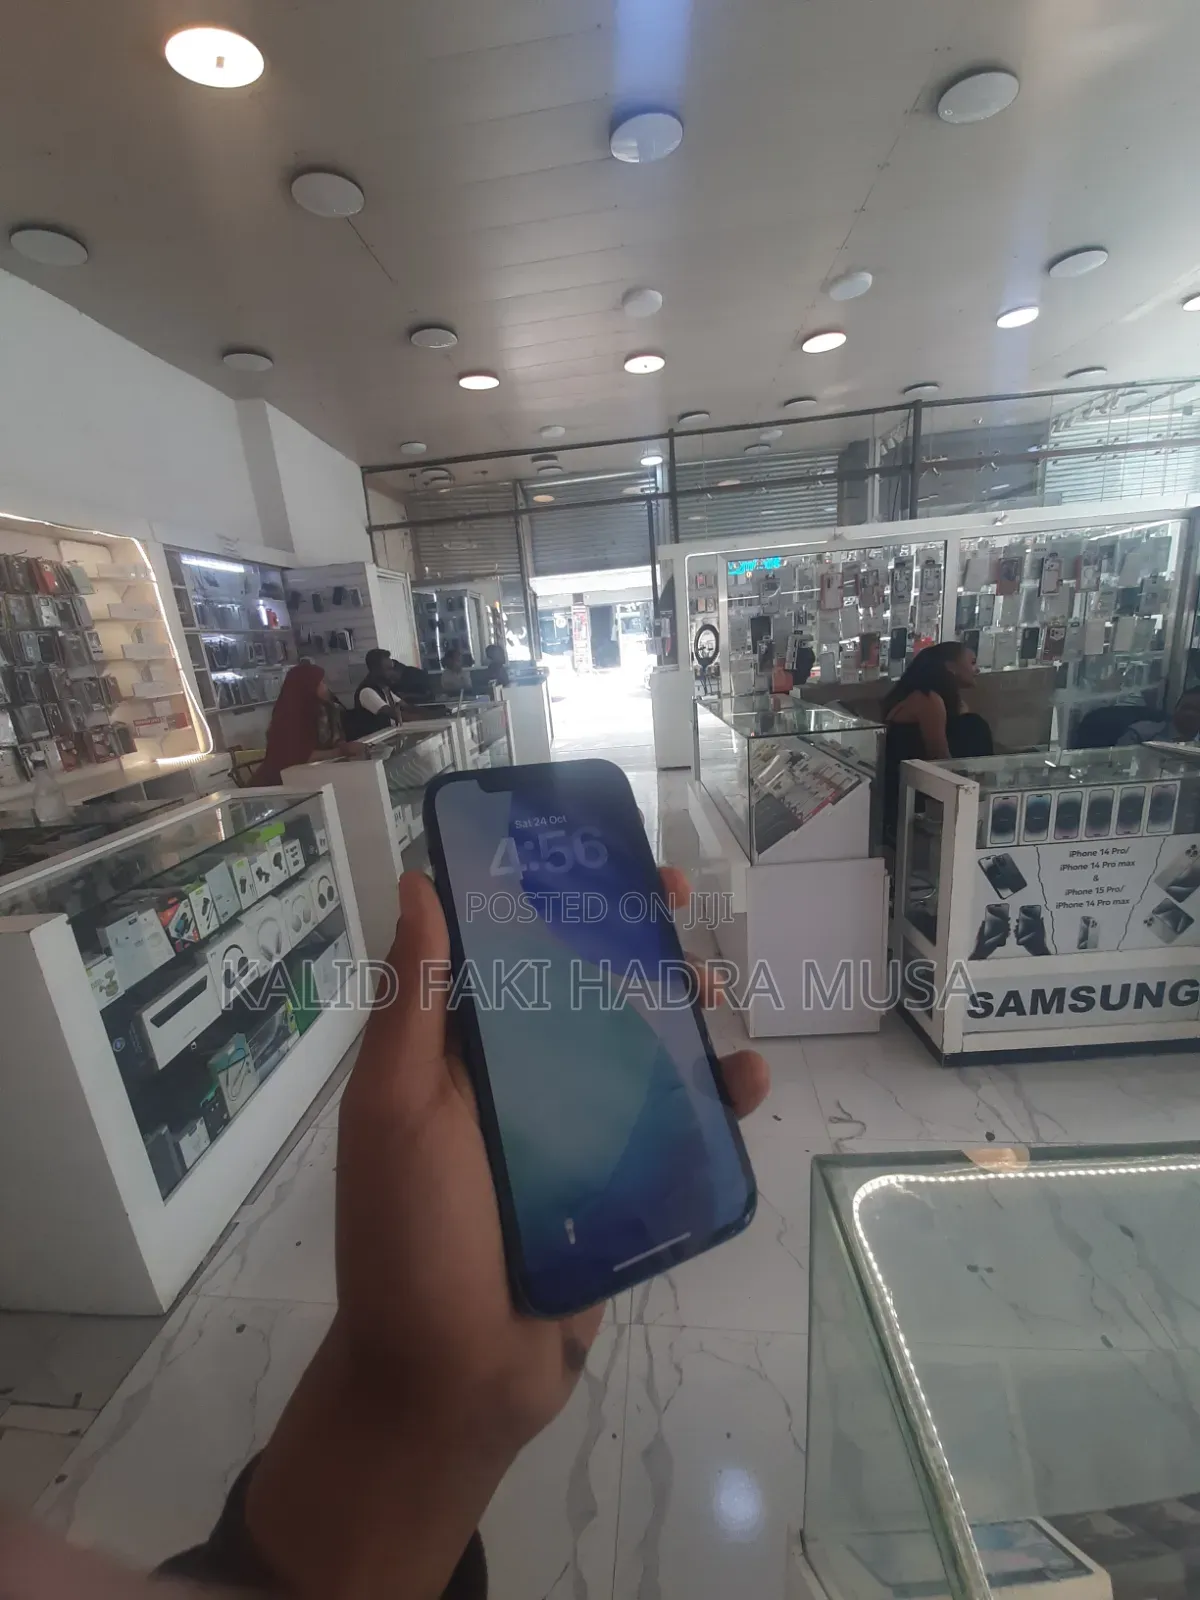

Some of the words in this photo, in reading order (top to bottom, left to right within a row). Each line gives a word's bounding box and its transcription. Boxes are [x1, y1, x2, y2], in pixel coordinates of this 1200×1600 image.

[514, 818, 534, 831] Sat
[534, 816, 549, 828] 24
[549, 814, 568, 827] Oct
[489, 825, 610, 882] 4:56
[1069, 849, 1098, 858] iPhone
[1100, 848, 1110, 856] 14
[1112, 846, 1131, 855] Pro/
[1060, 863, 1089, 872] iPhone
[1102, 861, 1116, 869] Pro
[1092, 874, 1099, 882] &
[1065, 888, 1093, 896] iPhone
[1095, 886, 1104, 894] 15
[1106, 885, 1126, 893] Pro/
[1056, 901, 1084, 909] iPhone
[967, 978, 1200, 1020] SAMSUNG
